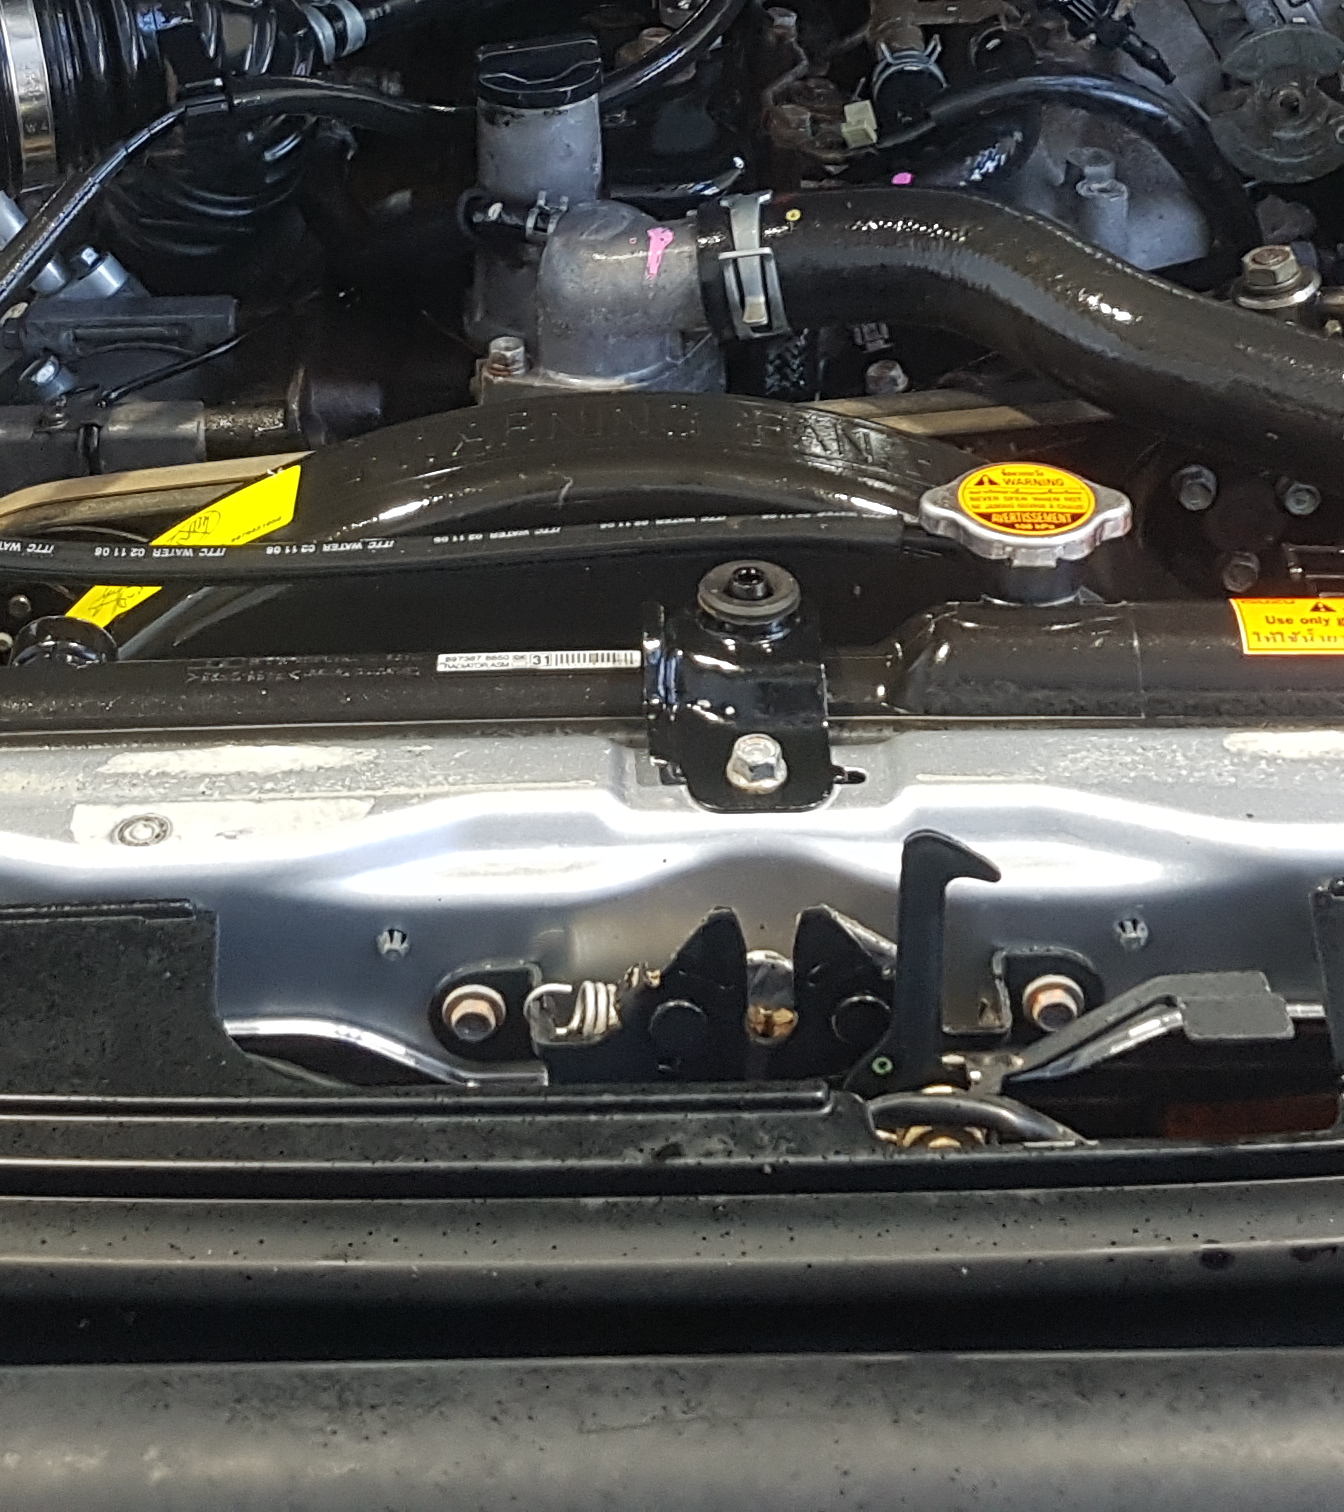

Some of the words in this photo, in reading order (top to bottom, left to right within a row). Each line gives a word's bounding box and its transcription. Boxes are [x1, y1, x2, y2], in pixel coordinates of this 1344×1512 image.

[1003, 478, 1065, 486] WARNING
[991, 512, 1072, 523] AVERTISSEMENT
[489, 529, 529, 540] WATER
[114, 547, 128, 558] 11
[131, 546, 146, 558] 02
[152, 546, 194, 558] WATER
[323, 541, 364, 553] WATER
[1265, 615, 1294, 626] Use
[1300, 615, 1331, 629] only
[532, 654, 551, 666] 31
